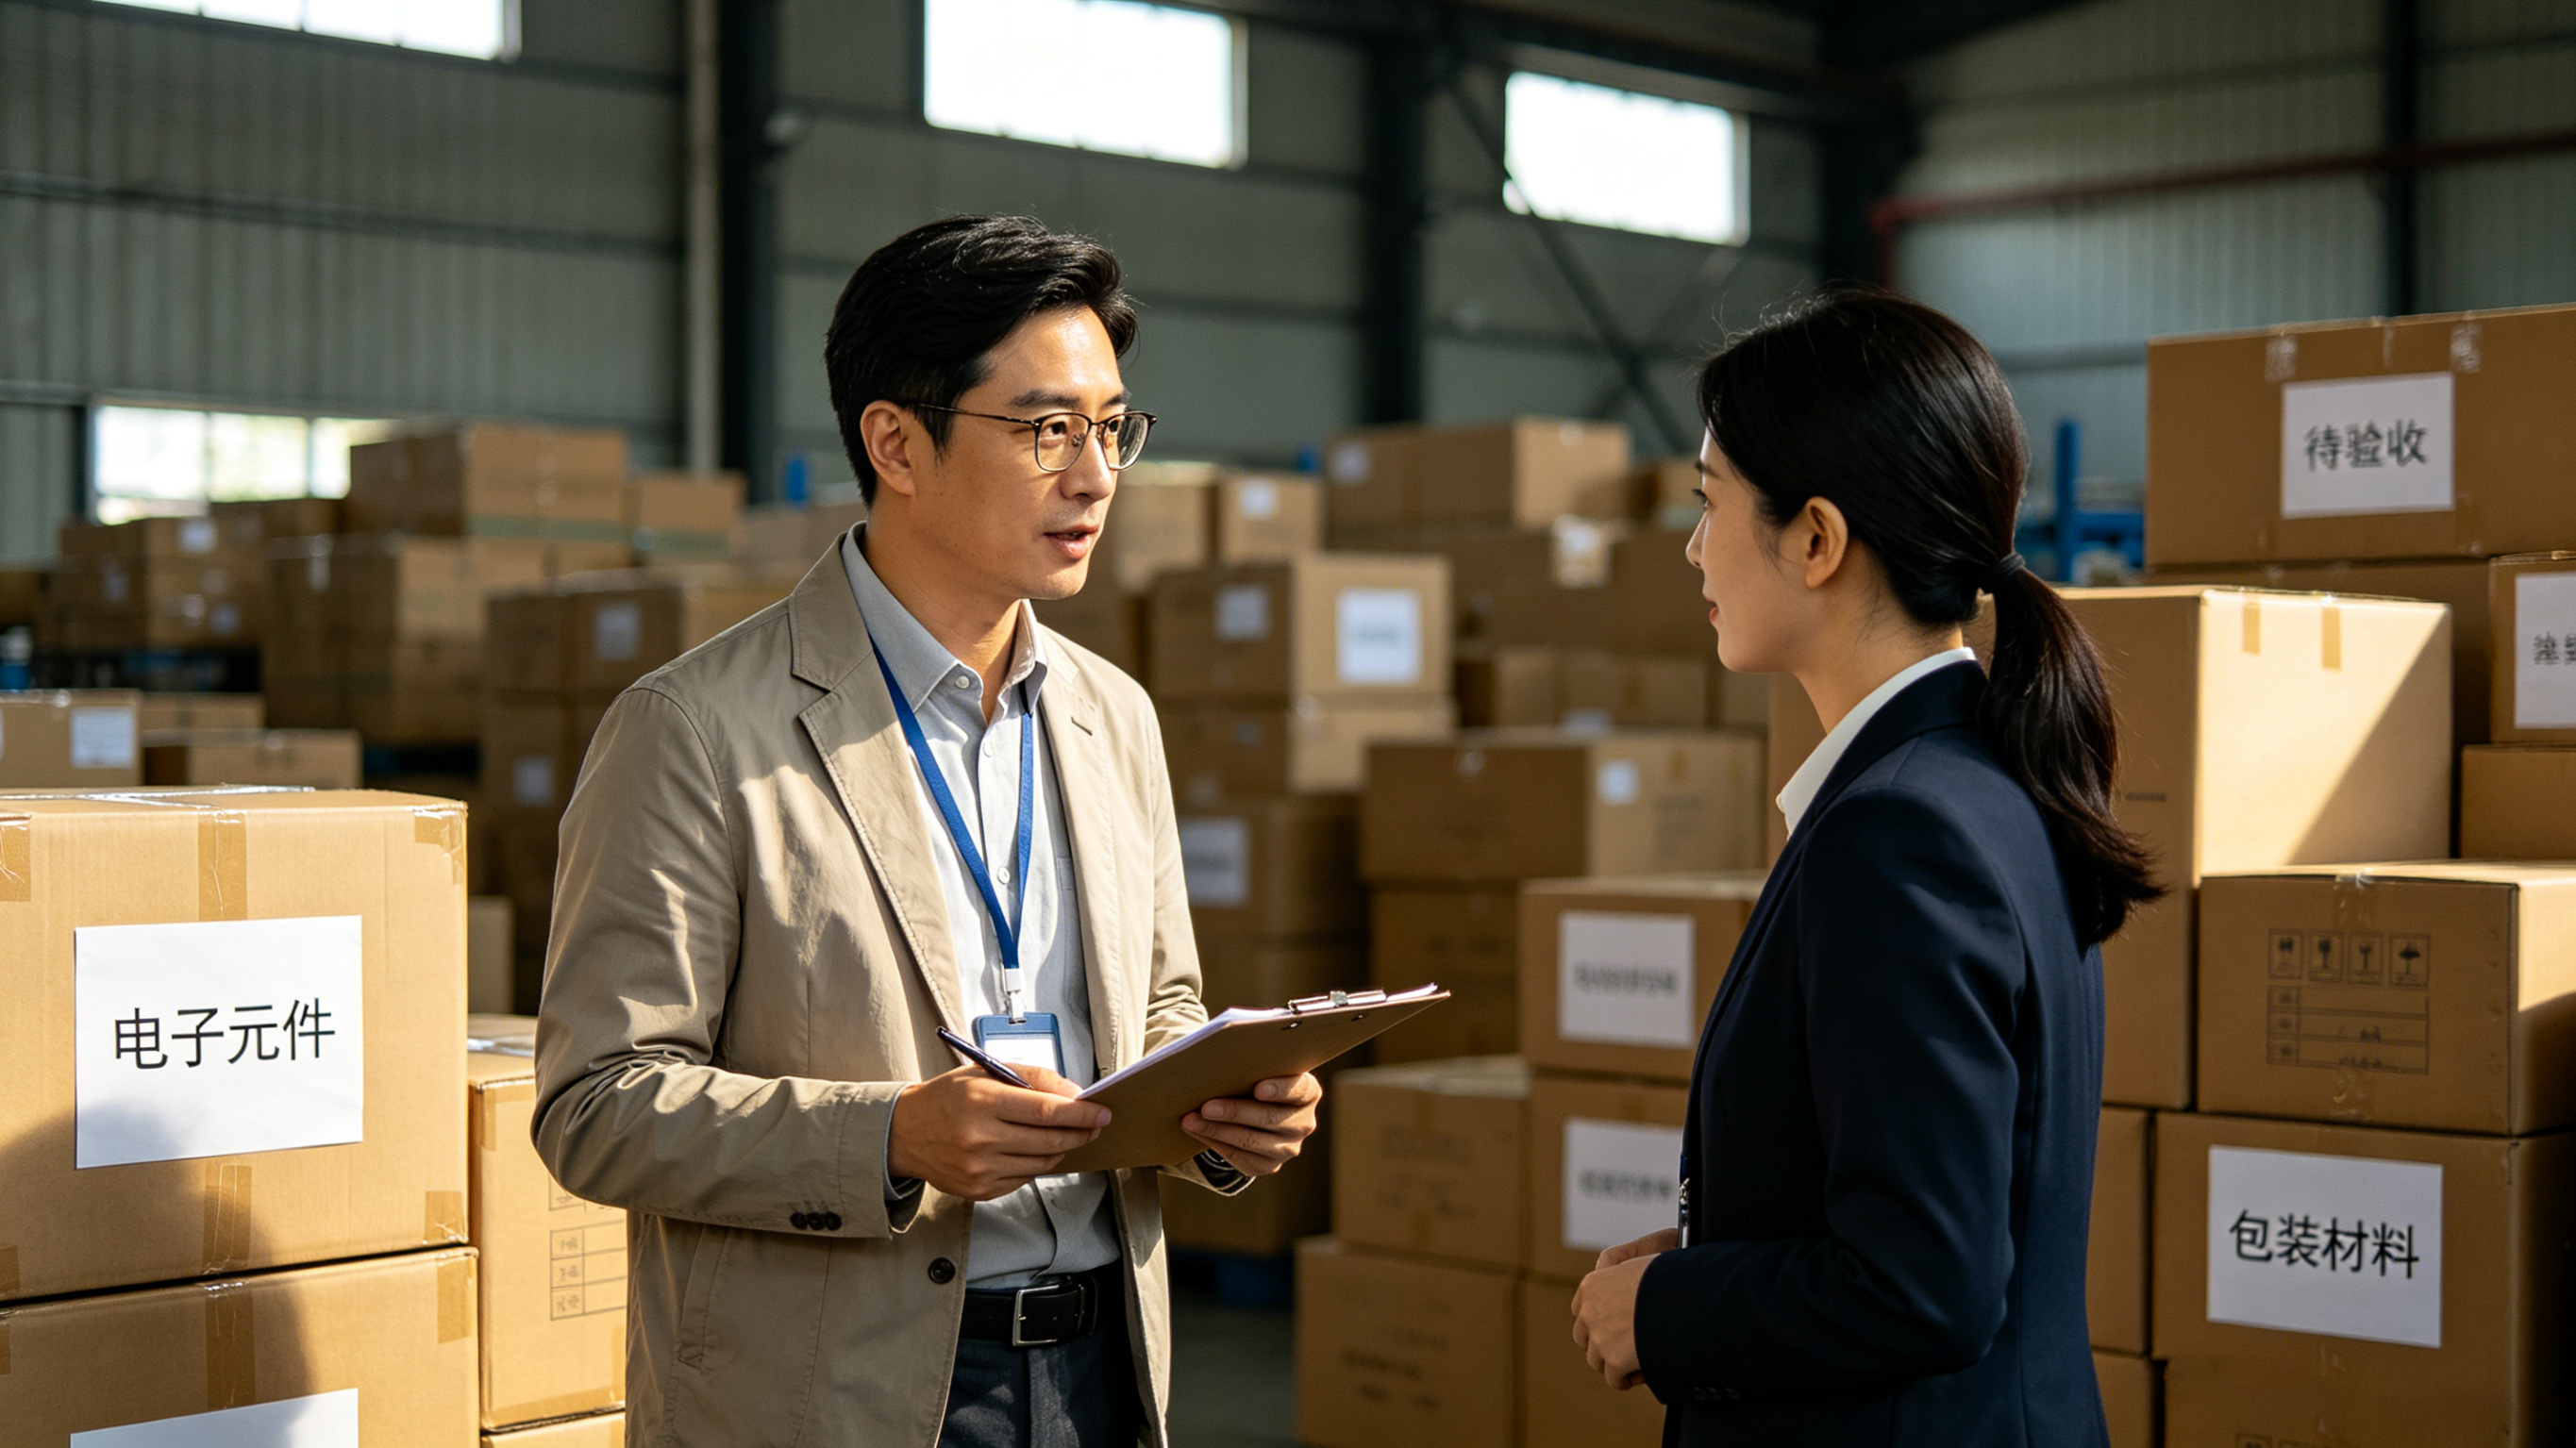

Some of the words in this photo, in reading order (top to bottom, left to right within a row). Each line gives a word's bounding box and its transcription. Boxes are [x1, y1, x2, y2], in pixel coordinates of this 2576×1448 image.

[2305, 419, 2429, 471] 待验收
[115, 997, 336, 1070] 电子元件
[2230, 1209, 2419, 1279] 包装材料
